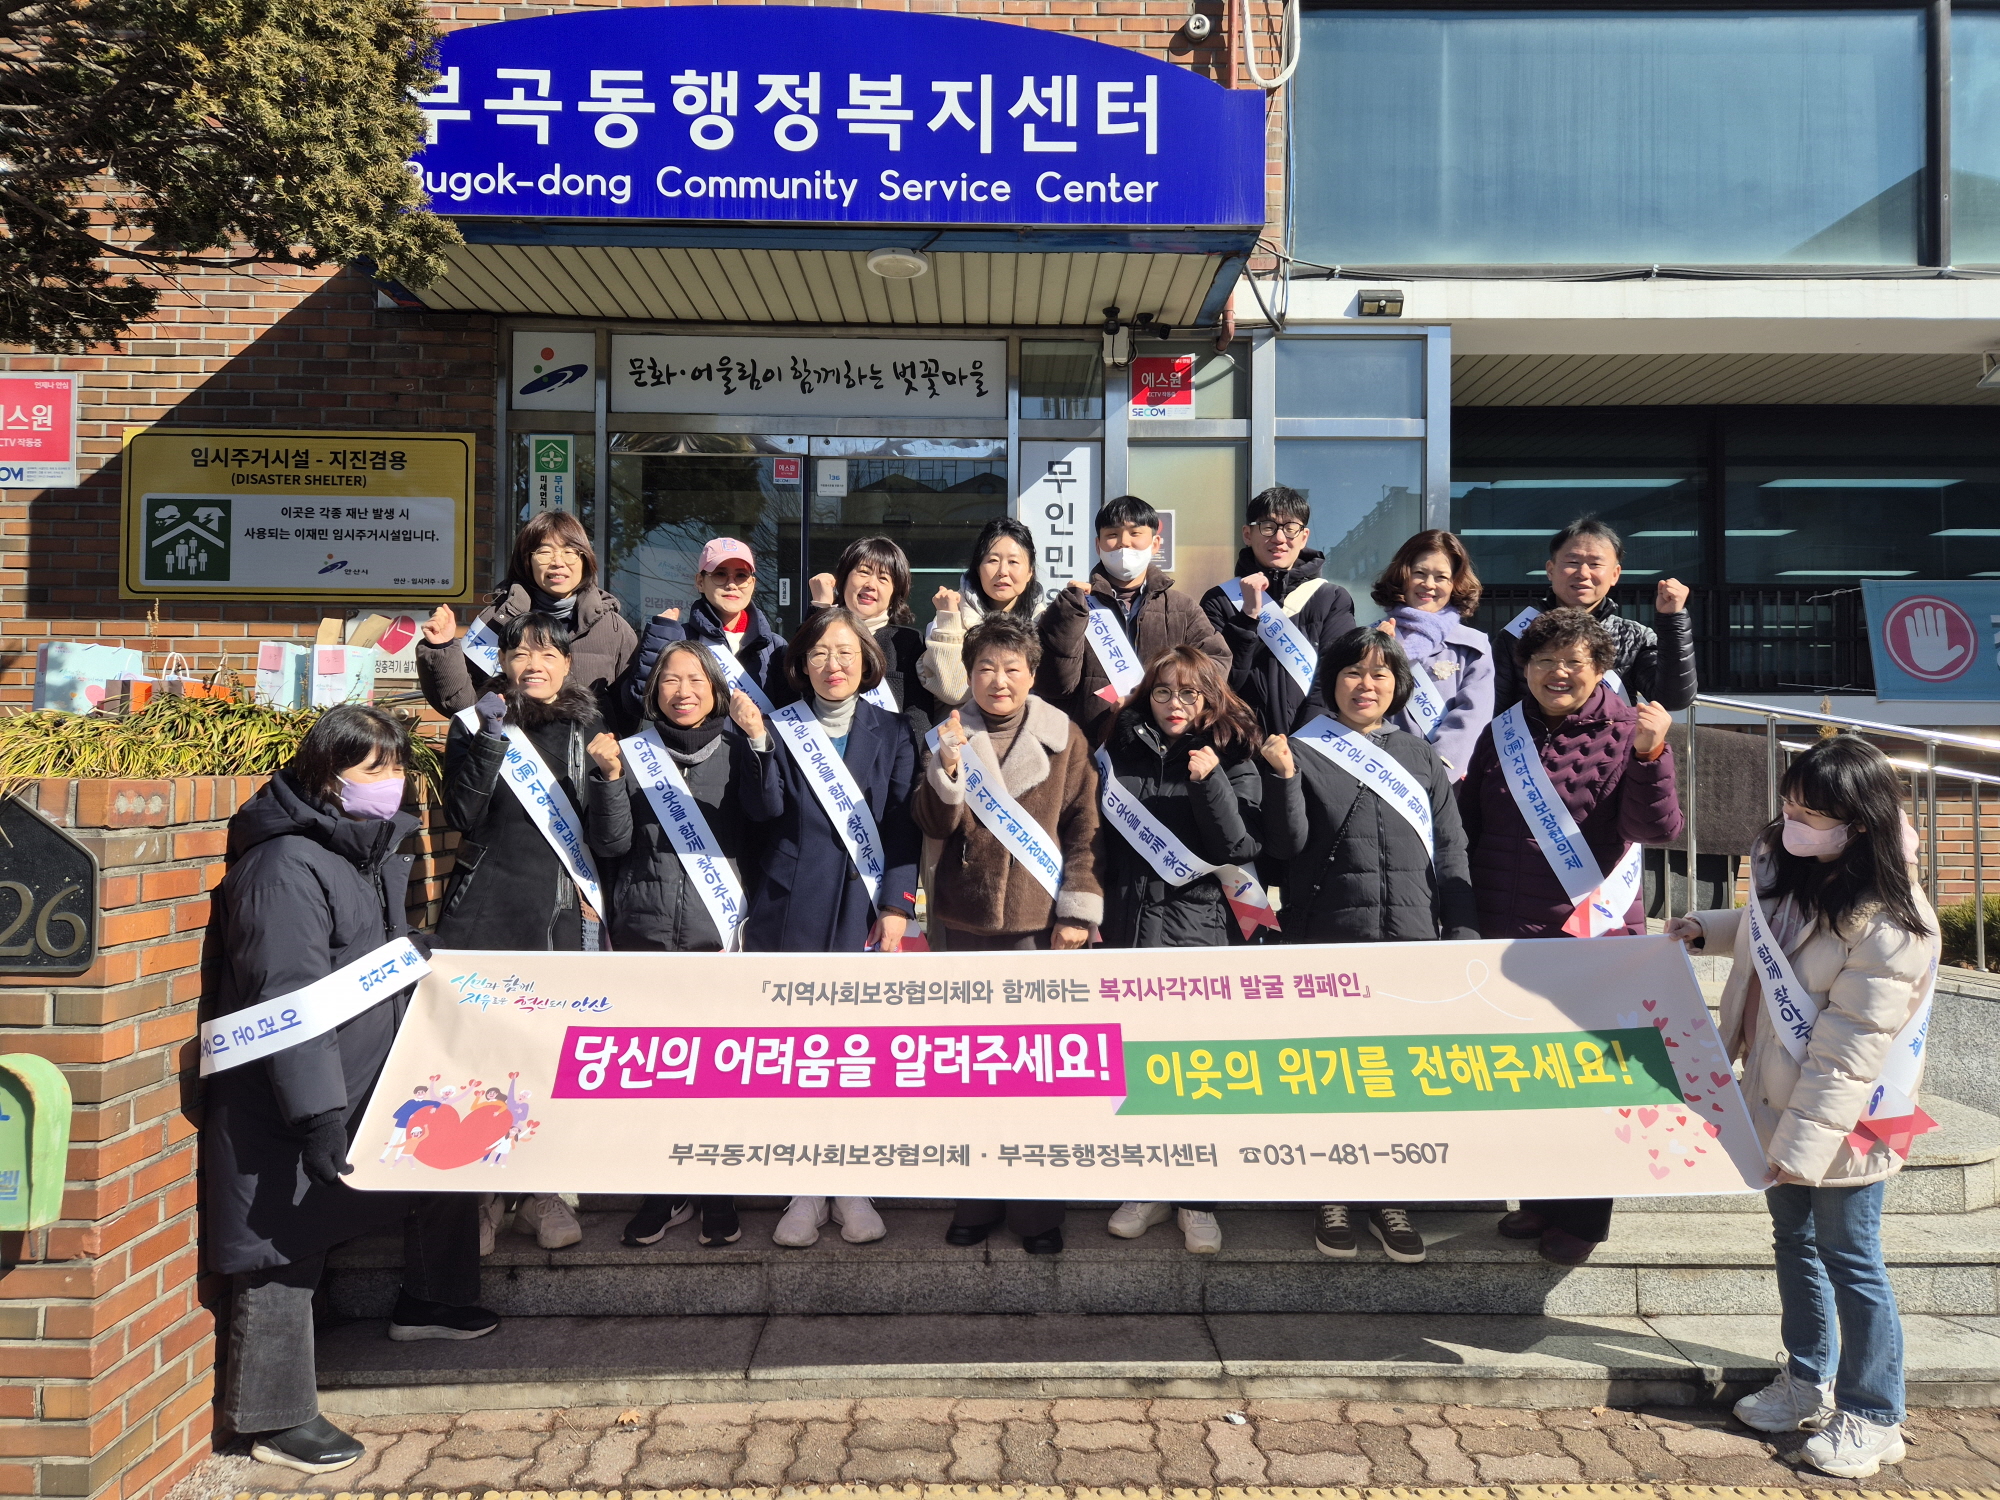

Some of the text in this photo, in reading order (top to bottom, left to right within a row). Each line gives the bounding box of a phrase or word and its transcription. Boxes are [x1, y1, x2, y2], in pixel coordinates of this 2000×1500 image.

[408, 66, 1157, 155] 부곡동행정복지센터
[404, 161, 1159, 207] Bugok-dong Community Service Center
[34, 381, 54, 389] 언제나
[790, 355, 885, 395] 함께하는
[892, 357, 989, 399] 벚꽃마을
[1141, 372, 1181, 388] 에스원
[1132, 408, 1165, 417] SECOM
[17, 438, 42, 447] 작동중
[190, 447, 310, 470] 임시주거시설
[328, 450, 408, 471] 지진겸용
[231, 473, 367, 489] (DISASTER SHELTER)
[539, 475, 548, 508] 미세먼지
[554, 475, 563, 505] 무더위
[280, 506, 410, 521] 이곳은 각종 재난 발생 시
[244, 527, 440, 543] 사용되는 이재민 임시주거시설입니다.
[344, 567, 369, 577] 안산시
[393, 577, 407, 585] 안산
[411, 578, 436, 586] 임시거주
[441, 578, 450, 586] 86
[1089, 611, 1129, 673] 찾아주세요
[374, 660, 402, 673] 장충격기
[1320, 729, 1431, 826] 어려운 이웃을 함께
[781, 706, 884, 890] 어려운 이웃을 함께 찾아주세요
[633, 737, 742, 930] 어려운 이웃을 함께 찾아주세요
[1107, 791, 1142, 831] 이웃을
[1138, 825, 1168, 854] 함께
[0, 880, 86, 957] 26
[358, 958, 400, 992] 안산시
[1757, 942, 1783, 980] 함께
[450, 971, 500, 993] 시민과
[760, 972, 1373, 1006] 『지역사회보장협의체와 함께하는 복지사각지대 발굴 캠페인』
[458, 992, 613, 1013] 자유로운 혁신도시 안산
[232, 1008, 302, 1047] 어려운
[573, 1032, 1111, 1091] 당신의 어려움을 알려주세요!
[1146, 1040, 1634, 1101] 이웃의 위기를 전해주세요!
[668, 1142, 971, 1168] 부곡동지역사회보장협의체
[997, 1142, 1218, 1168] 부곡동행정복지센터
